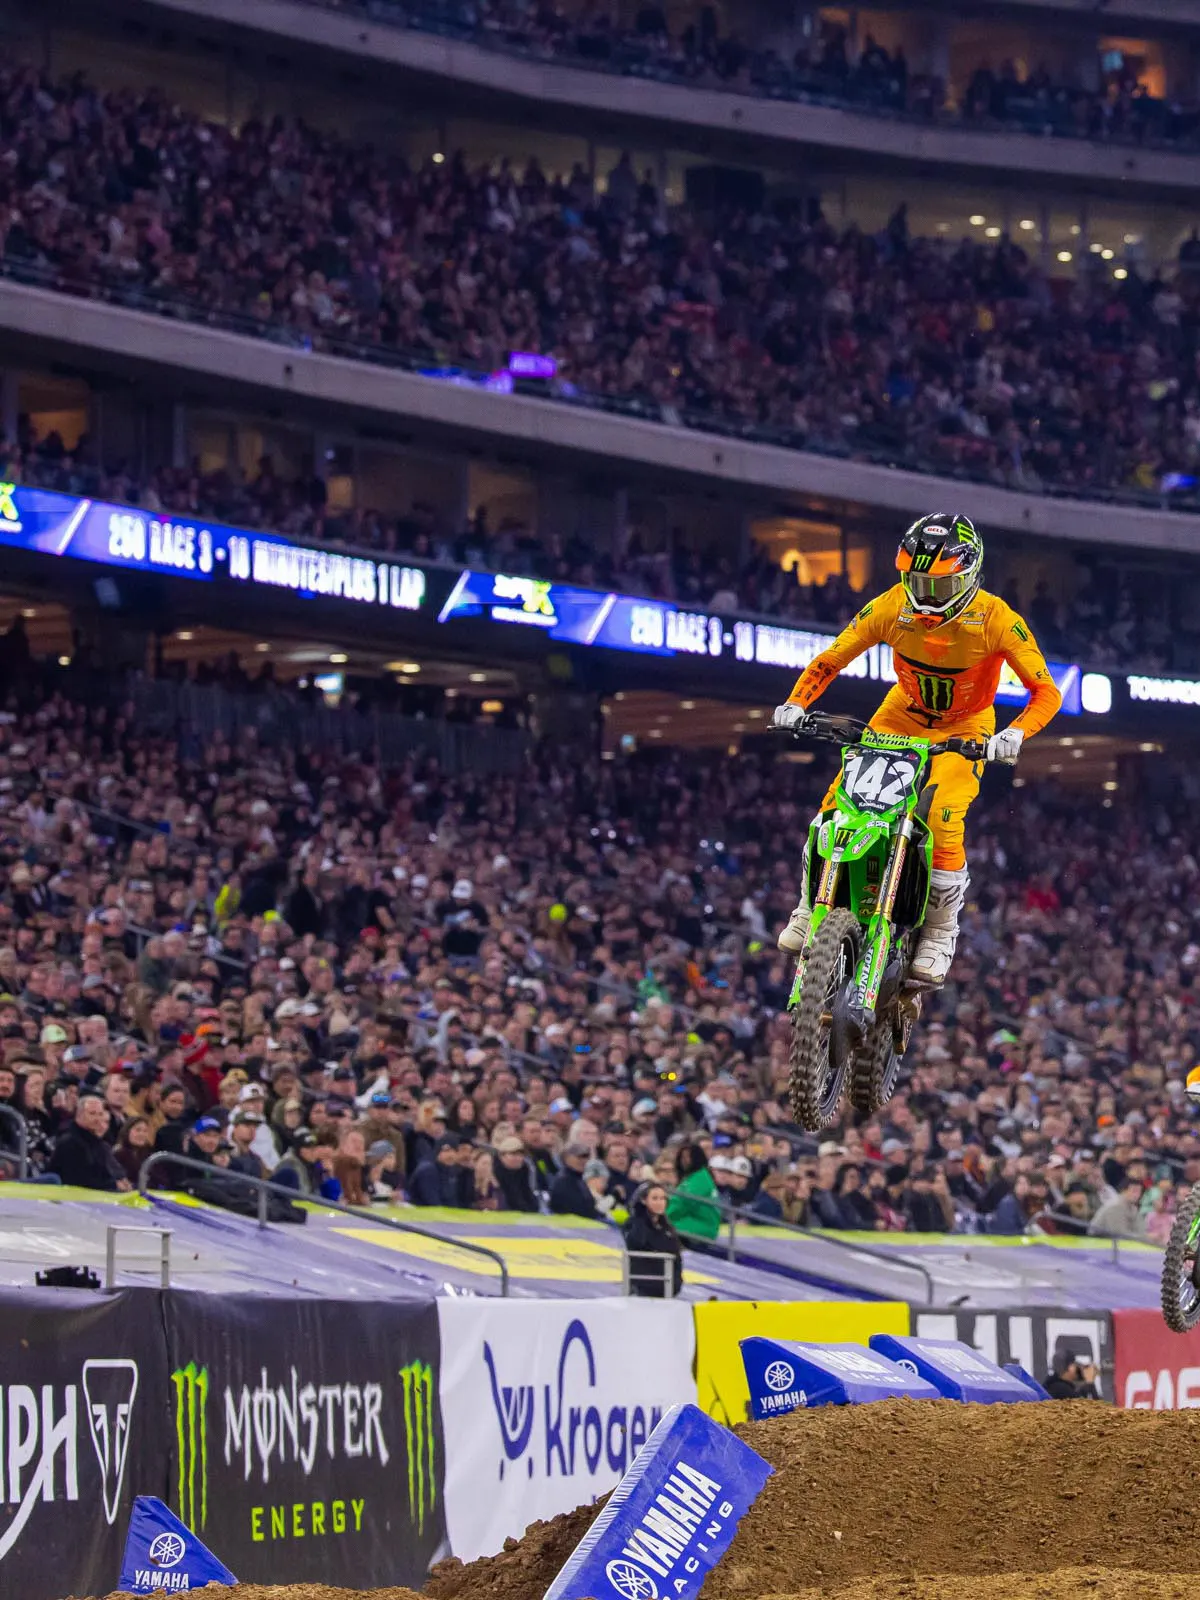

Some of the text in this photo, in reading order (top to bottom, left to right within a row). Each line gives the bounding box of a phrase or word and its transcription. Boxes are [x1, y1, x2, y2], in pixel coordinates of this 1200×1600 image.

[389, 565, 425, 610] LAP
[845, 757, 915, 806] 142
[760, 1389, 808, 1411] YAMAHA
[224, 1365, 390, 1483] MONSTER
[252, 1499, 365, 1541] ENERGY
[622, 1461, 722, 1578] YAMAHA
[662, 1501, 734, 1600] ACING
[135, 1569, 189, 1589] YAMAHA
